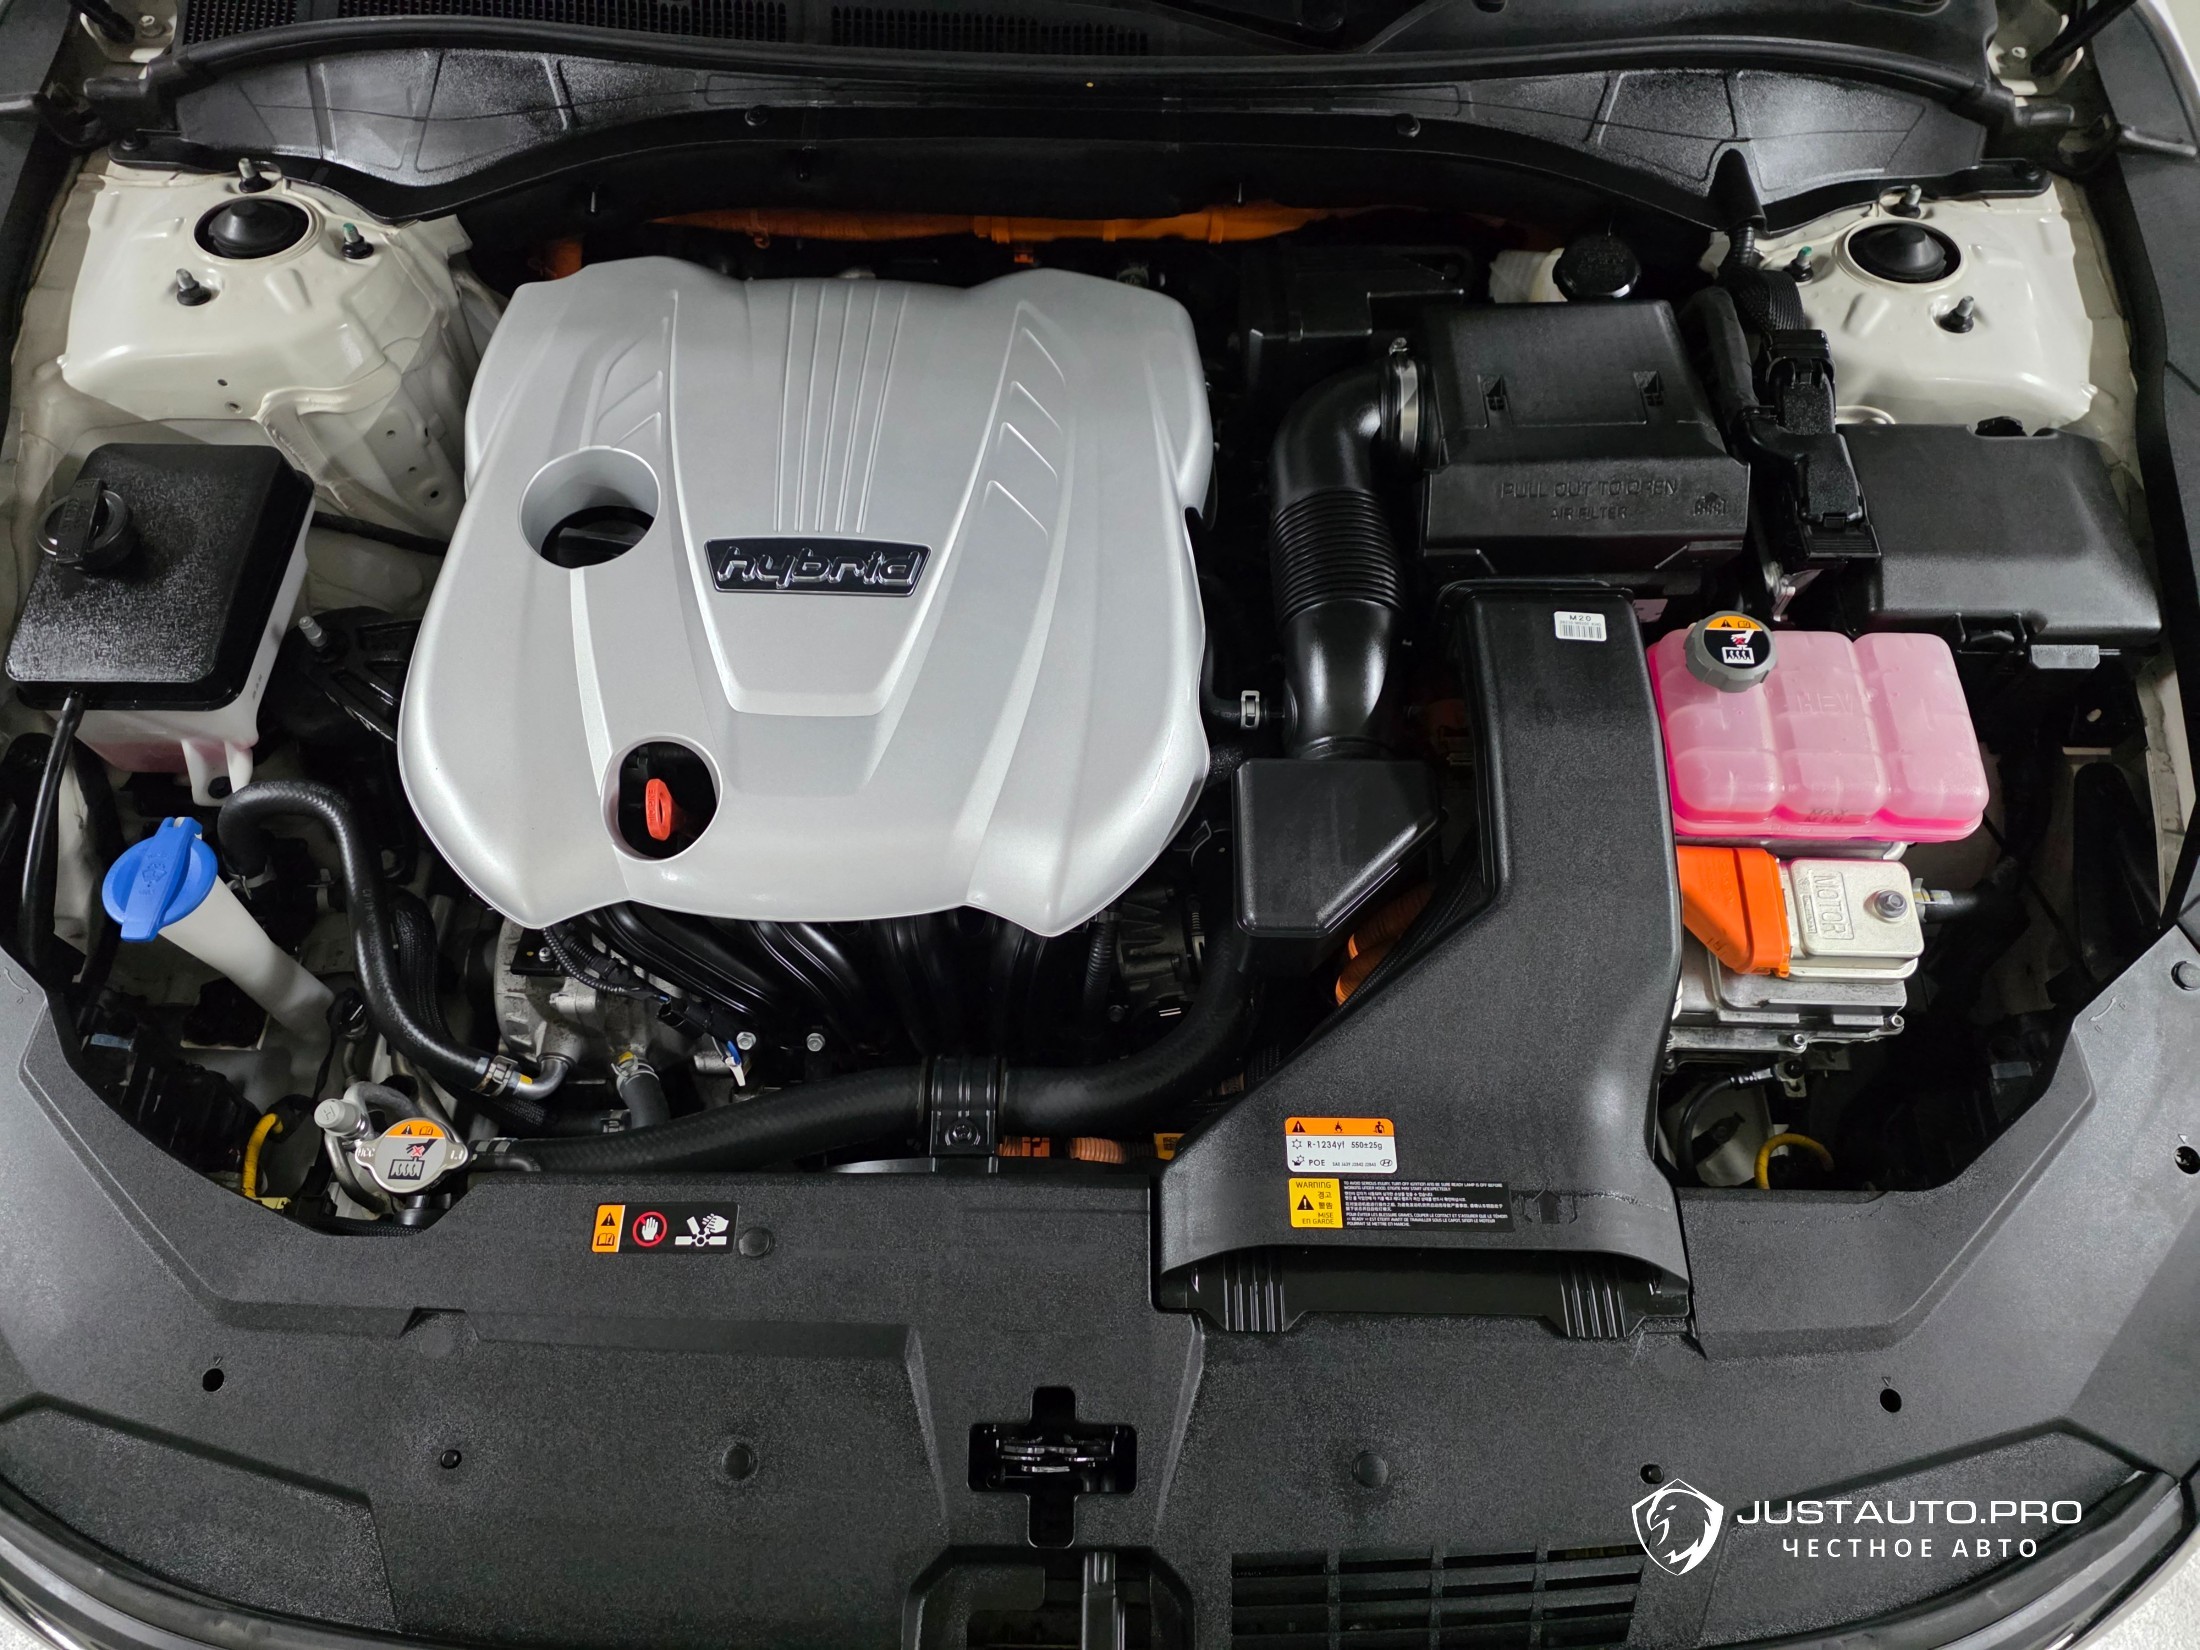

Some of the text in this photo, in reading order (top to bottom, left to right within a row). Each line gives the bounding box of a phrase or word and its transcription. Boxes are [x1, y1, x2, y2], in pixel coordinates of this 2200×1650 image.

[1501, 477, 1678, 499] PULL OUT TO OPEN
[1550, 506, 1628, 520] AIR FILTER
[717, 546, 923, 590] hybrid
[1569, 614, 1592, 622] M20
[1813, 875, 1847, 934] MOTOR
[1351, 1142, 1383, 1150] 550±25g
[1308, 1159, 1326, 1167] POE
[1296, 1181, 1332, 1189] WARNING
[1318, 1191, 1332, 1199] 경고
